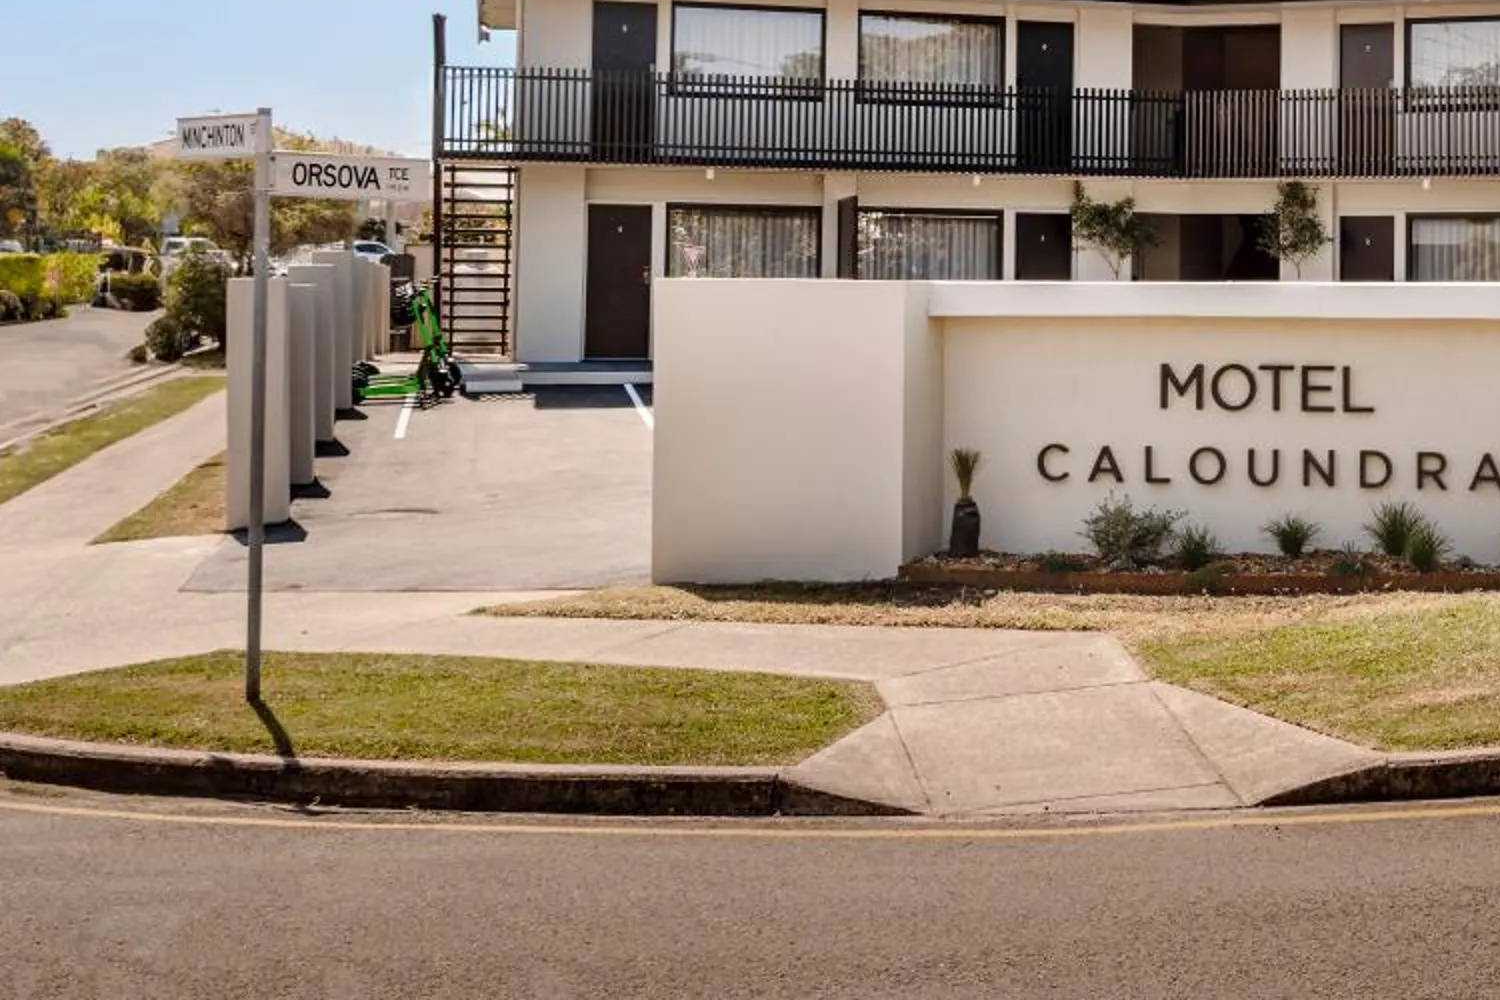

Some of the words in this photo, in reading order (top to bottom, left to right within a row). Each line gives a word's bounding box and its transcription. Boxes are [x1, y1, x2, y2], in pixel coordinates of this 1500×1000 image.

[181, 123, 245, 149] MINCHINTON
[292, 162, 381, 190] ORSOVA
[388, 167, 410, 181] TCE
[1159, 362, 1376, 413] MOTEL
